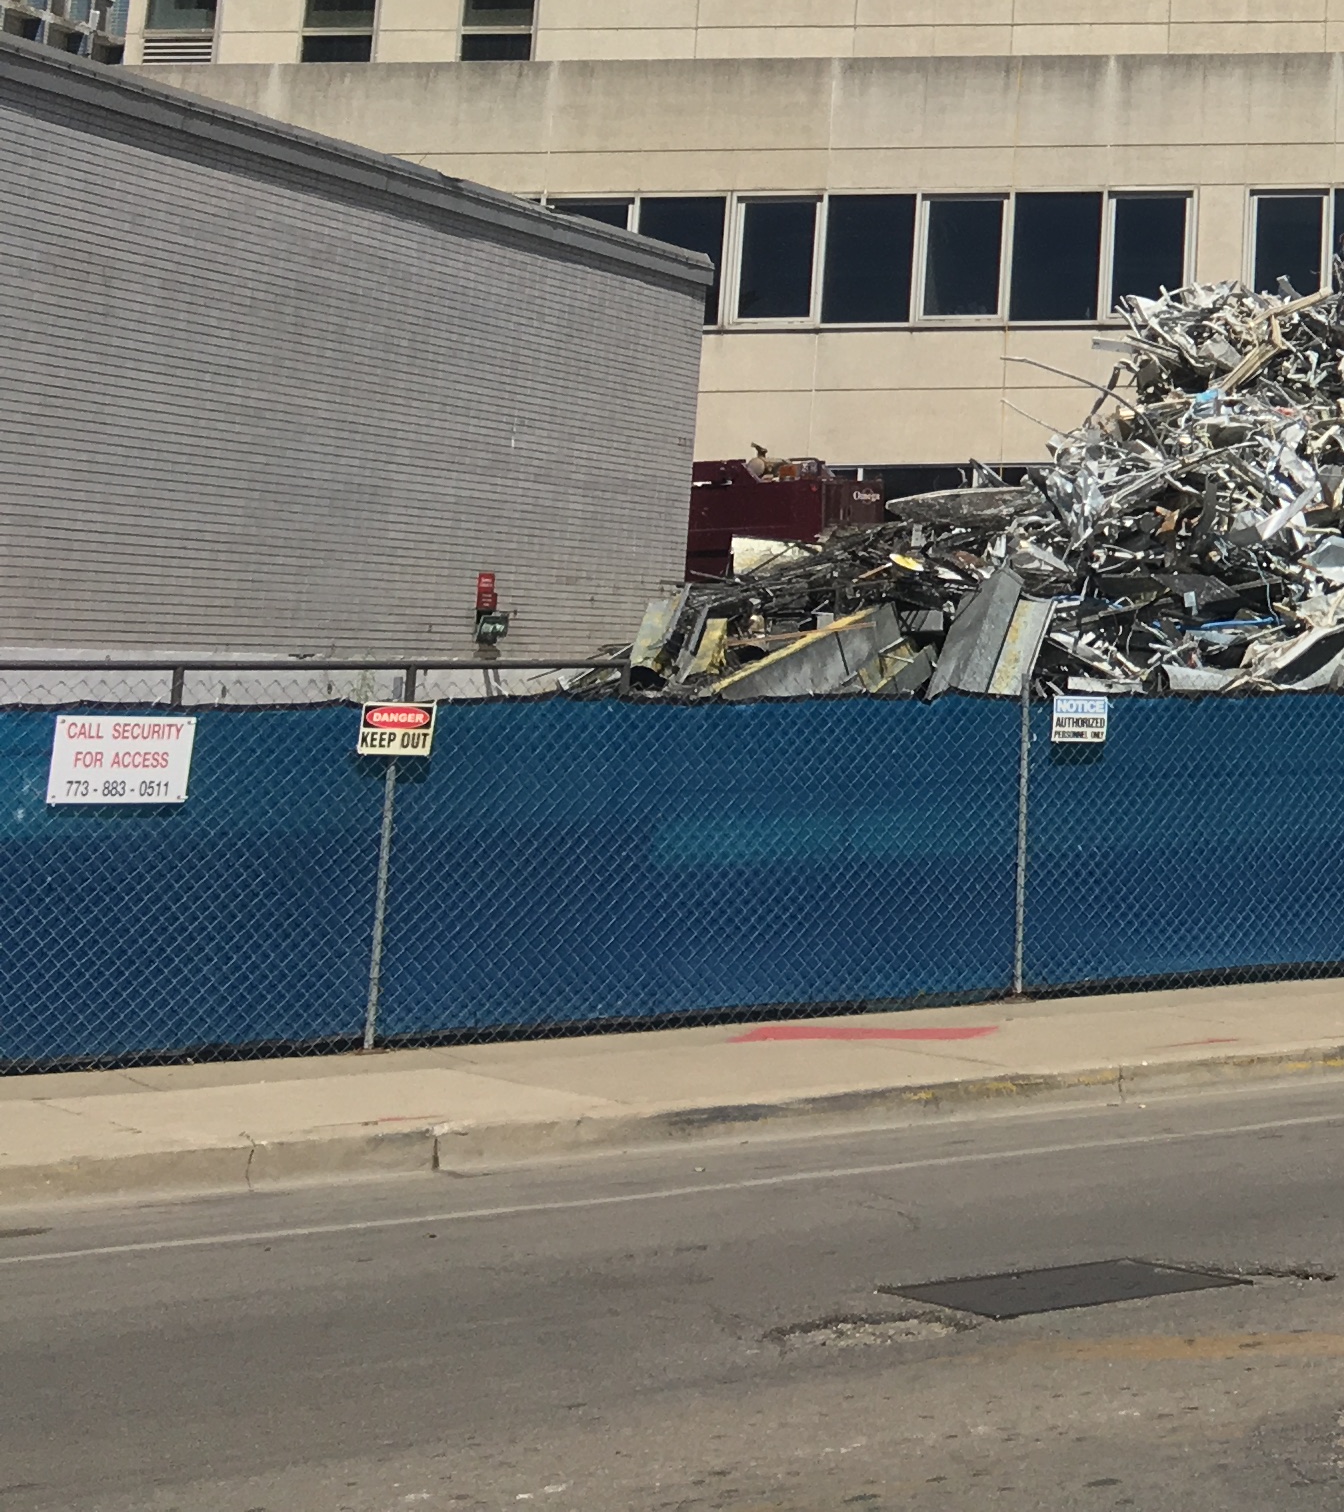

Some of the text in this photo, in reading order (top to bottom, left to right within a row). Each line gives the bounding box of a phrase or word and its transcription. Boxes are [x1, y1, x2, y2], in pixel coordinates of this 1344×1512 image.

[1056, 699, 1105, 712] NOTICE
[372, 712, 425, 723] DANGER
[1055, 717, 1105, 728] AUTHORIZED
[67, 722, 184, 741] CALL SECURITY
[360, 731, 430, 749] KEEP OUT
[73, 751, 170, 769] FOR ACCESS
[65, 780, 90, 798] 773
[102, 780, 127, 798] 883
[139, 780, 170, 798] 0511
